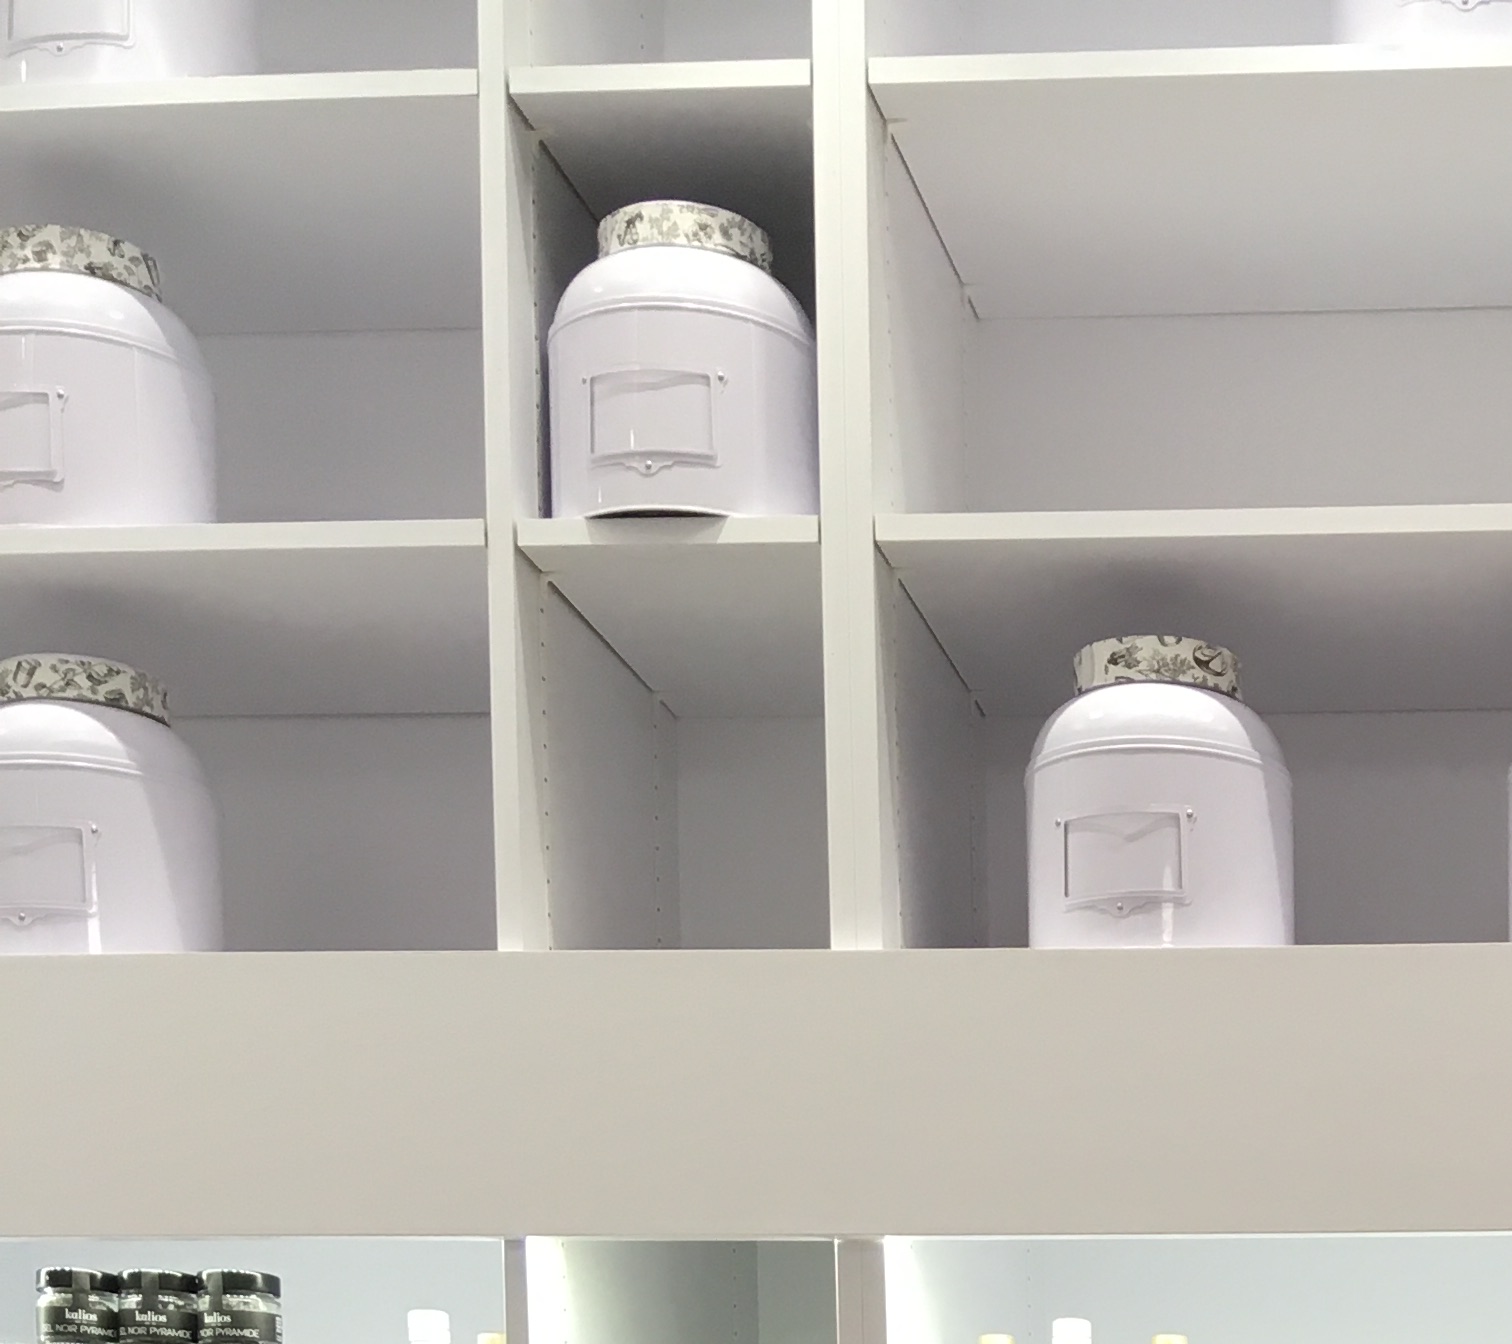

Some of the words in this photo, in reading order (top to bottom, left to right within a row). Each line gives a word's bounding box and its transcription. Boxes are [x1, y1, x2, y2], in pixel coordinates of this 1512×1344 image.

[65, 1308, 98, 1321] kalios
[135, 1310, 167, 1322] kalios
[204, 1312, 232, 1324] kalios
[216, 1328, 260, 1338] PYRAMIDE
